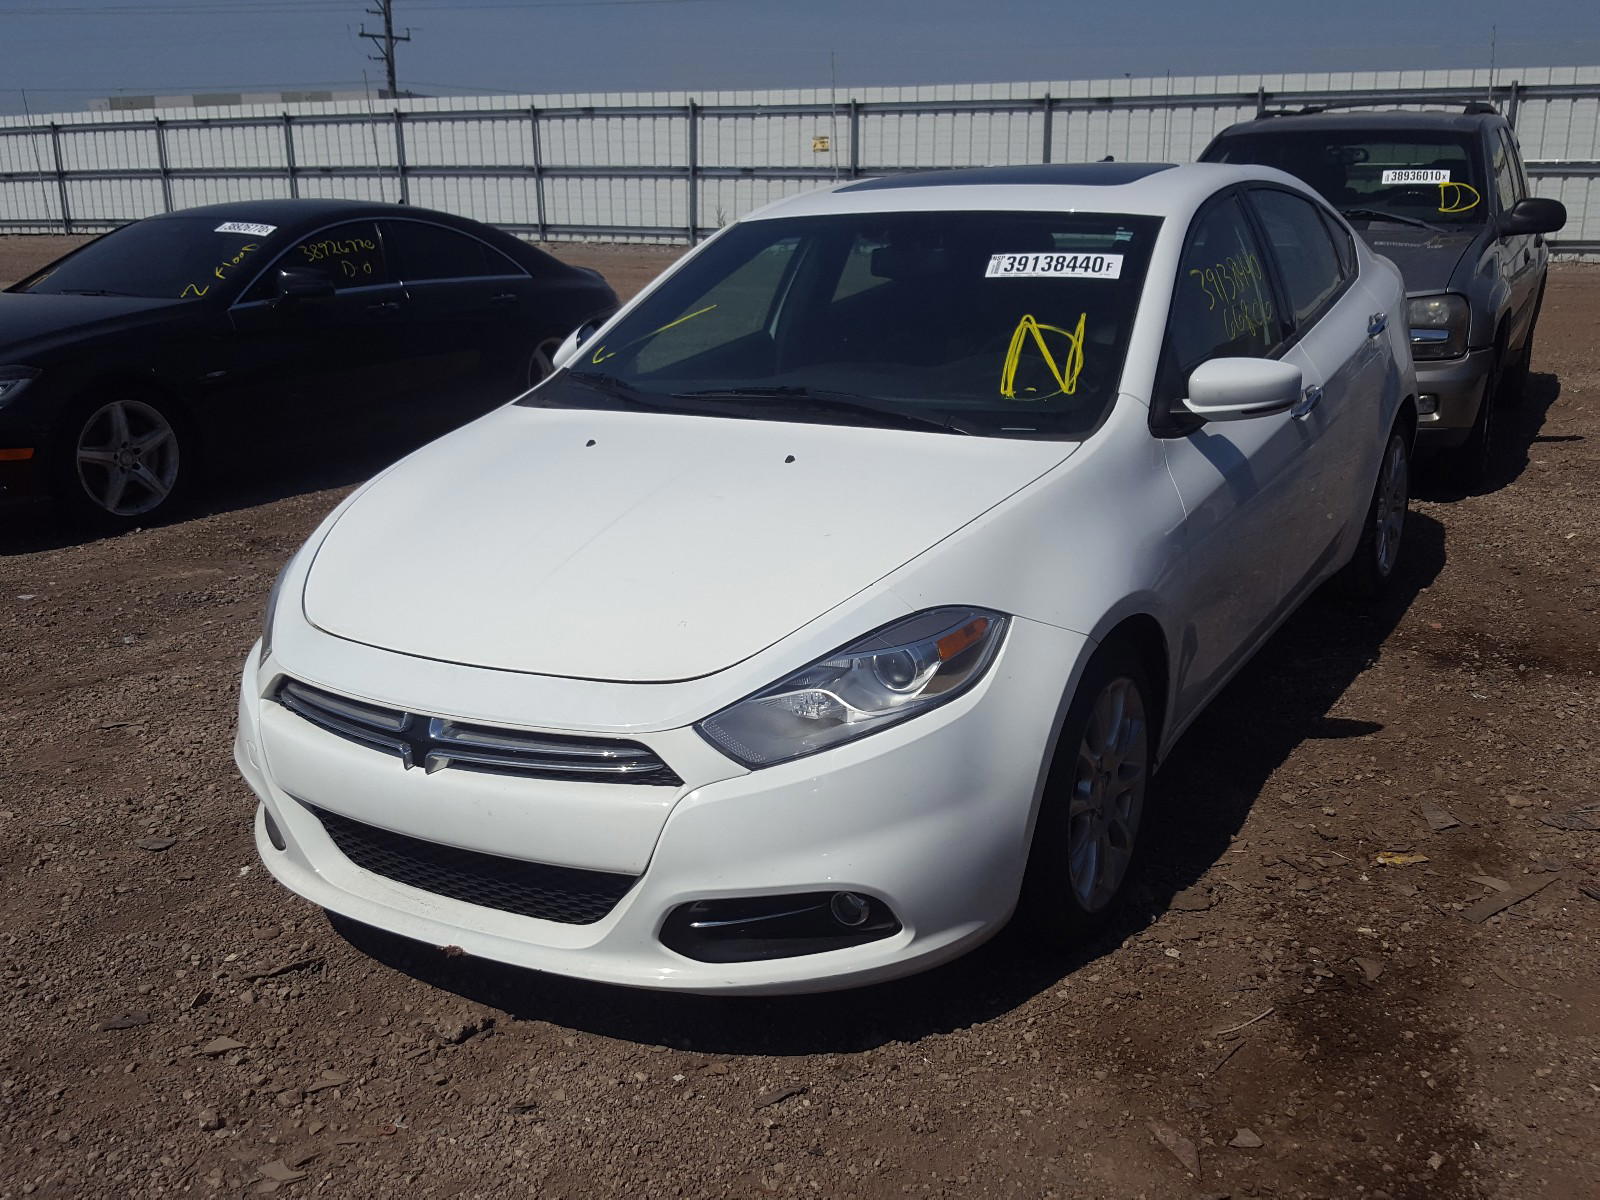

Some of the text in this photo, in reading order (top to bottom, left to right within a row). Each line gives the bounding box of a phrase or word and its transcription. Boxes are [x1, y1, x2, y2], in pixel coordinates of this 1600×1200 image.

[1391, 171, 1441, 181] 38936010
[1003, 256, 1114, 272] 39138440 F
[1001, 313, 1087, 399] N
